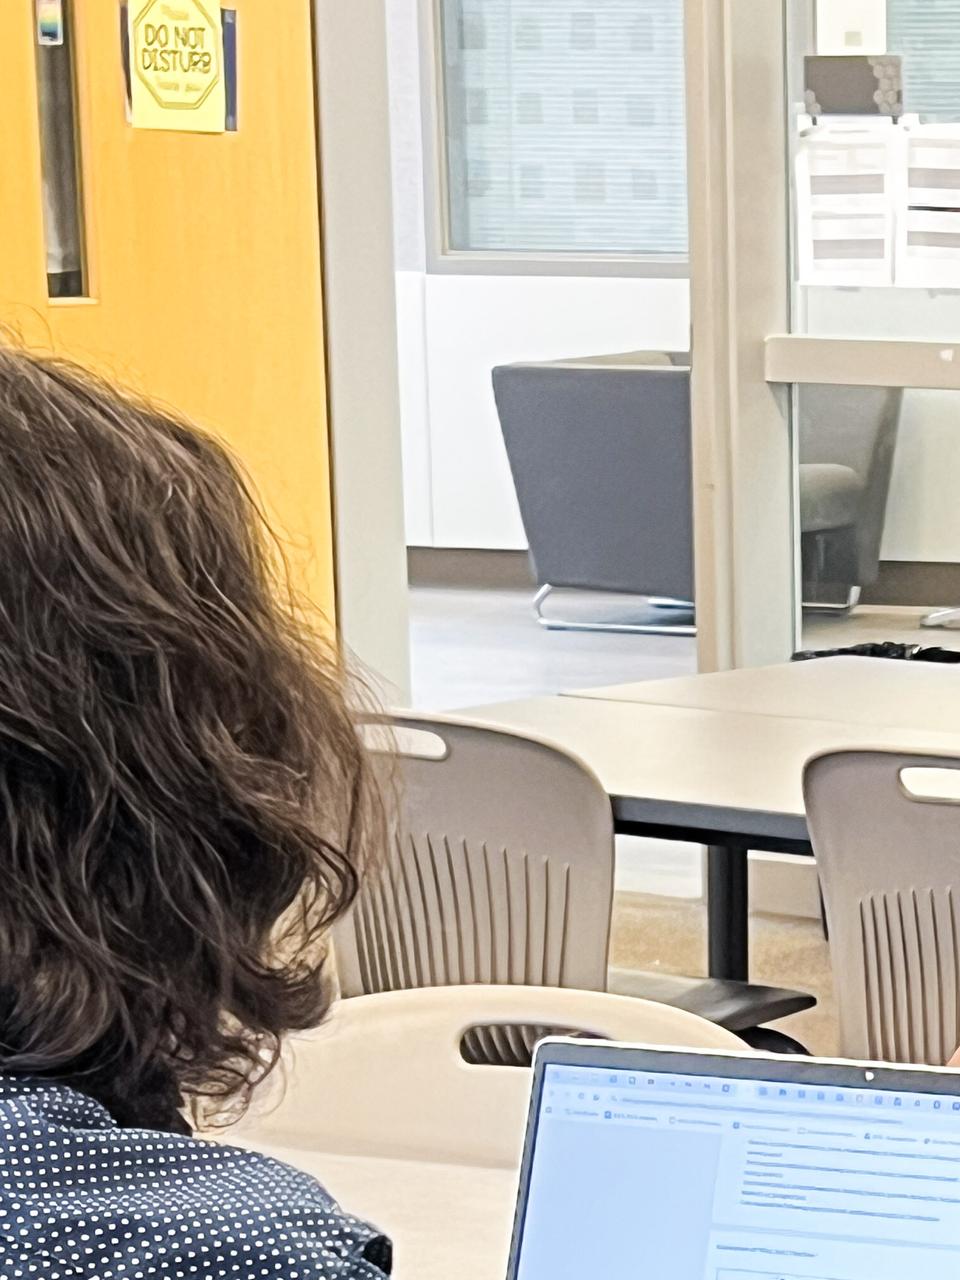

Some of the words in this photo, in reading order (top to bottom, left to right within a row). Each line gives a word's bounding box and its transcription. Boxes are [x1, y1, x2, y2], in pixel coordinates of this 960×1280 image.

[144, 23, 169, 48] DO
[174, 26, 206, 49] NOT
[142, 48, 212, 74] DISTURB
